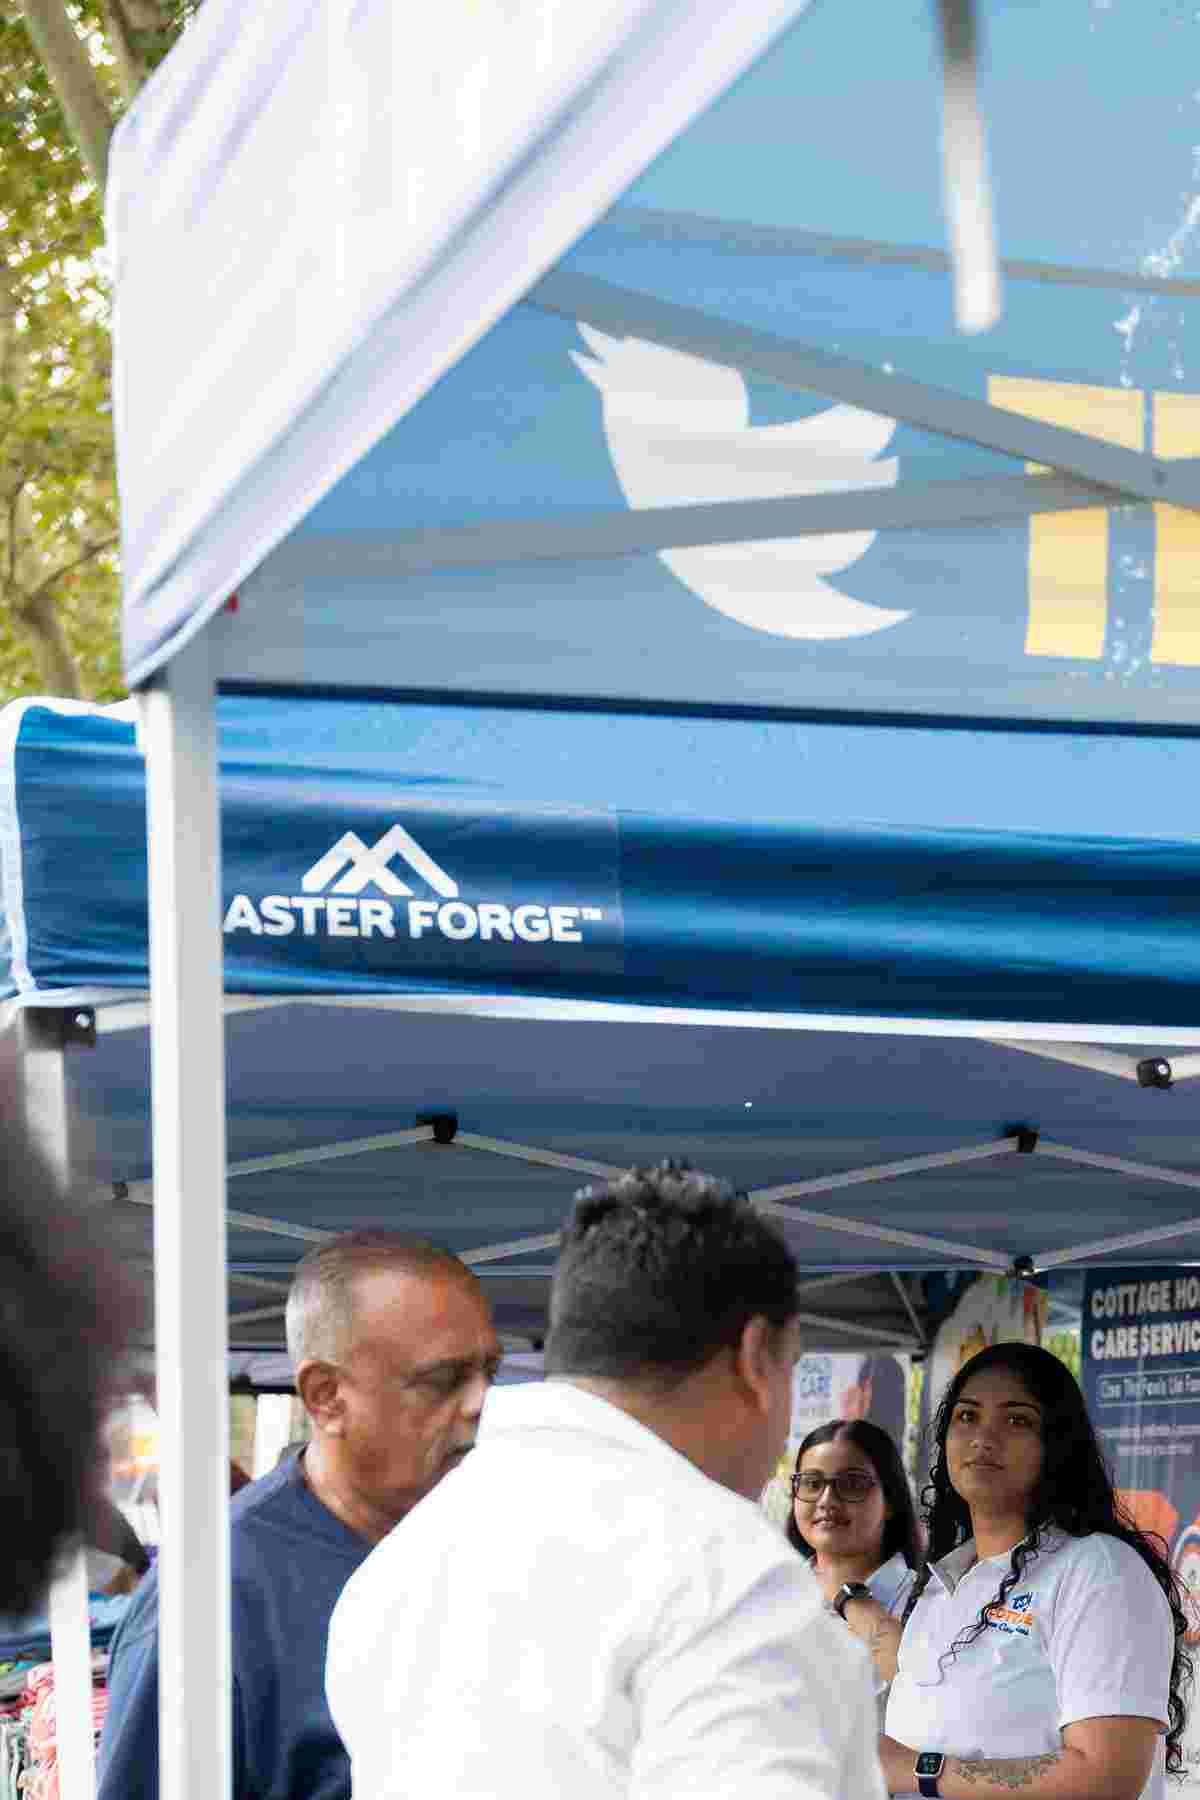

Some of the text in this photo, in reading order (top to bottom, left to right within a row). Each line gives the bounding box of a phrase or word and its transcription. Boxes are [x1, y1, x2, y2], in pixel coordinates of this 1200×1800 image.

[222, 895, 396, 939] ASTER
[1091, 1281, 1171, 1319] COTTAGE
[1091, 1324, 1138, 1360] CARE
